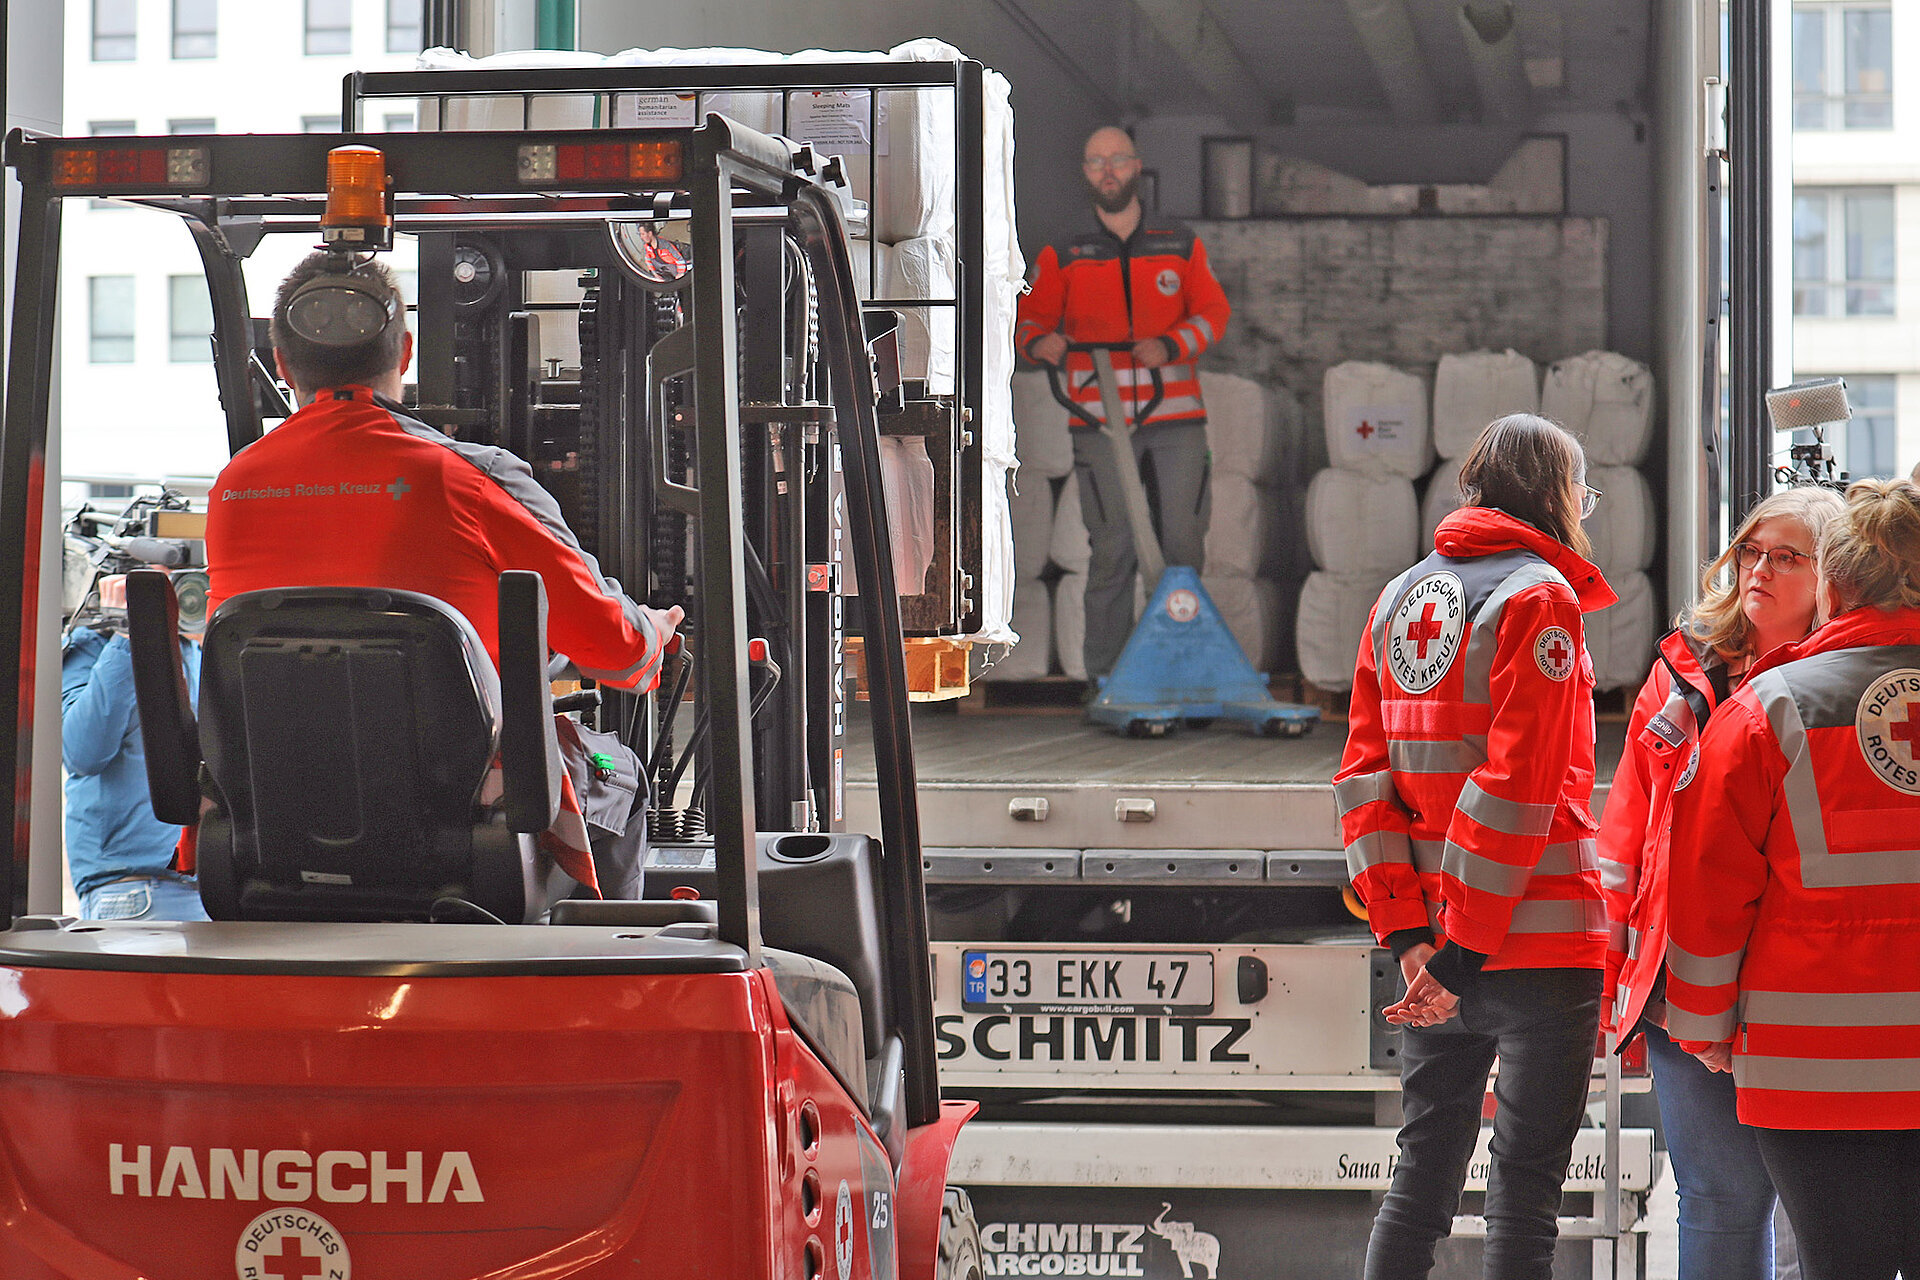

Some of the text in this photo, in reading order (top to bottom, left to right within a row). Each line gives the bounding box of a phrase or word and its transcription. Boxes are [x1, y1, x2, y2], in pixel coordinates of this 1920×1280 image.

[222, 481, 381, 501] Deutsches Rotes Kreuz
[833, 491, 843, 736] HANGCHA
[1400, 580, 1459, 619] DEUTSCHES
[1391, 632, 1456, 684] ROTES KREUZ
[1868, 678, 1920, 717] DEUTS
[1867, 735, 1918, 785] ROTES
[968, 981, 985, 993] TR
[990, 960, 1190, 999] 33 EKK 47
[1040, 1004, 1135, 1015] www.cargobull.com
[935, 1015, 1252, 1063] SCHMITZ
[109, 1143, 485, 1204] HANGCHA
[1337, 1153, 1380, 1179] Sana
[872, 1190, 889, 1230] 25
[244, 1214, 340, 1256] DEUTSCHES
[978, 1223, 1146, 1253] CHMITZ
[982, 1253, 1144, 1277] ARGOBULL
